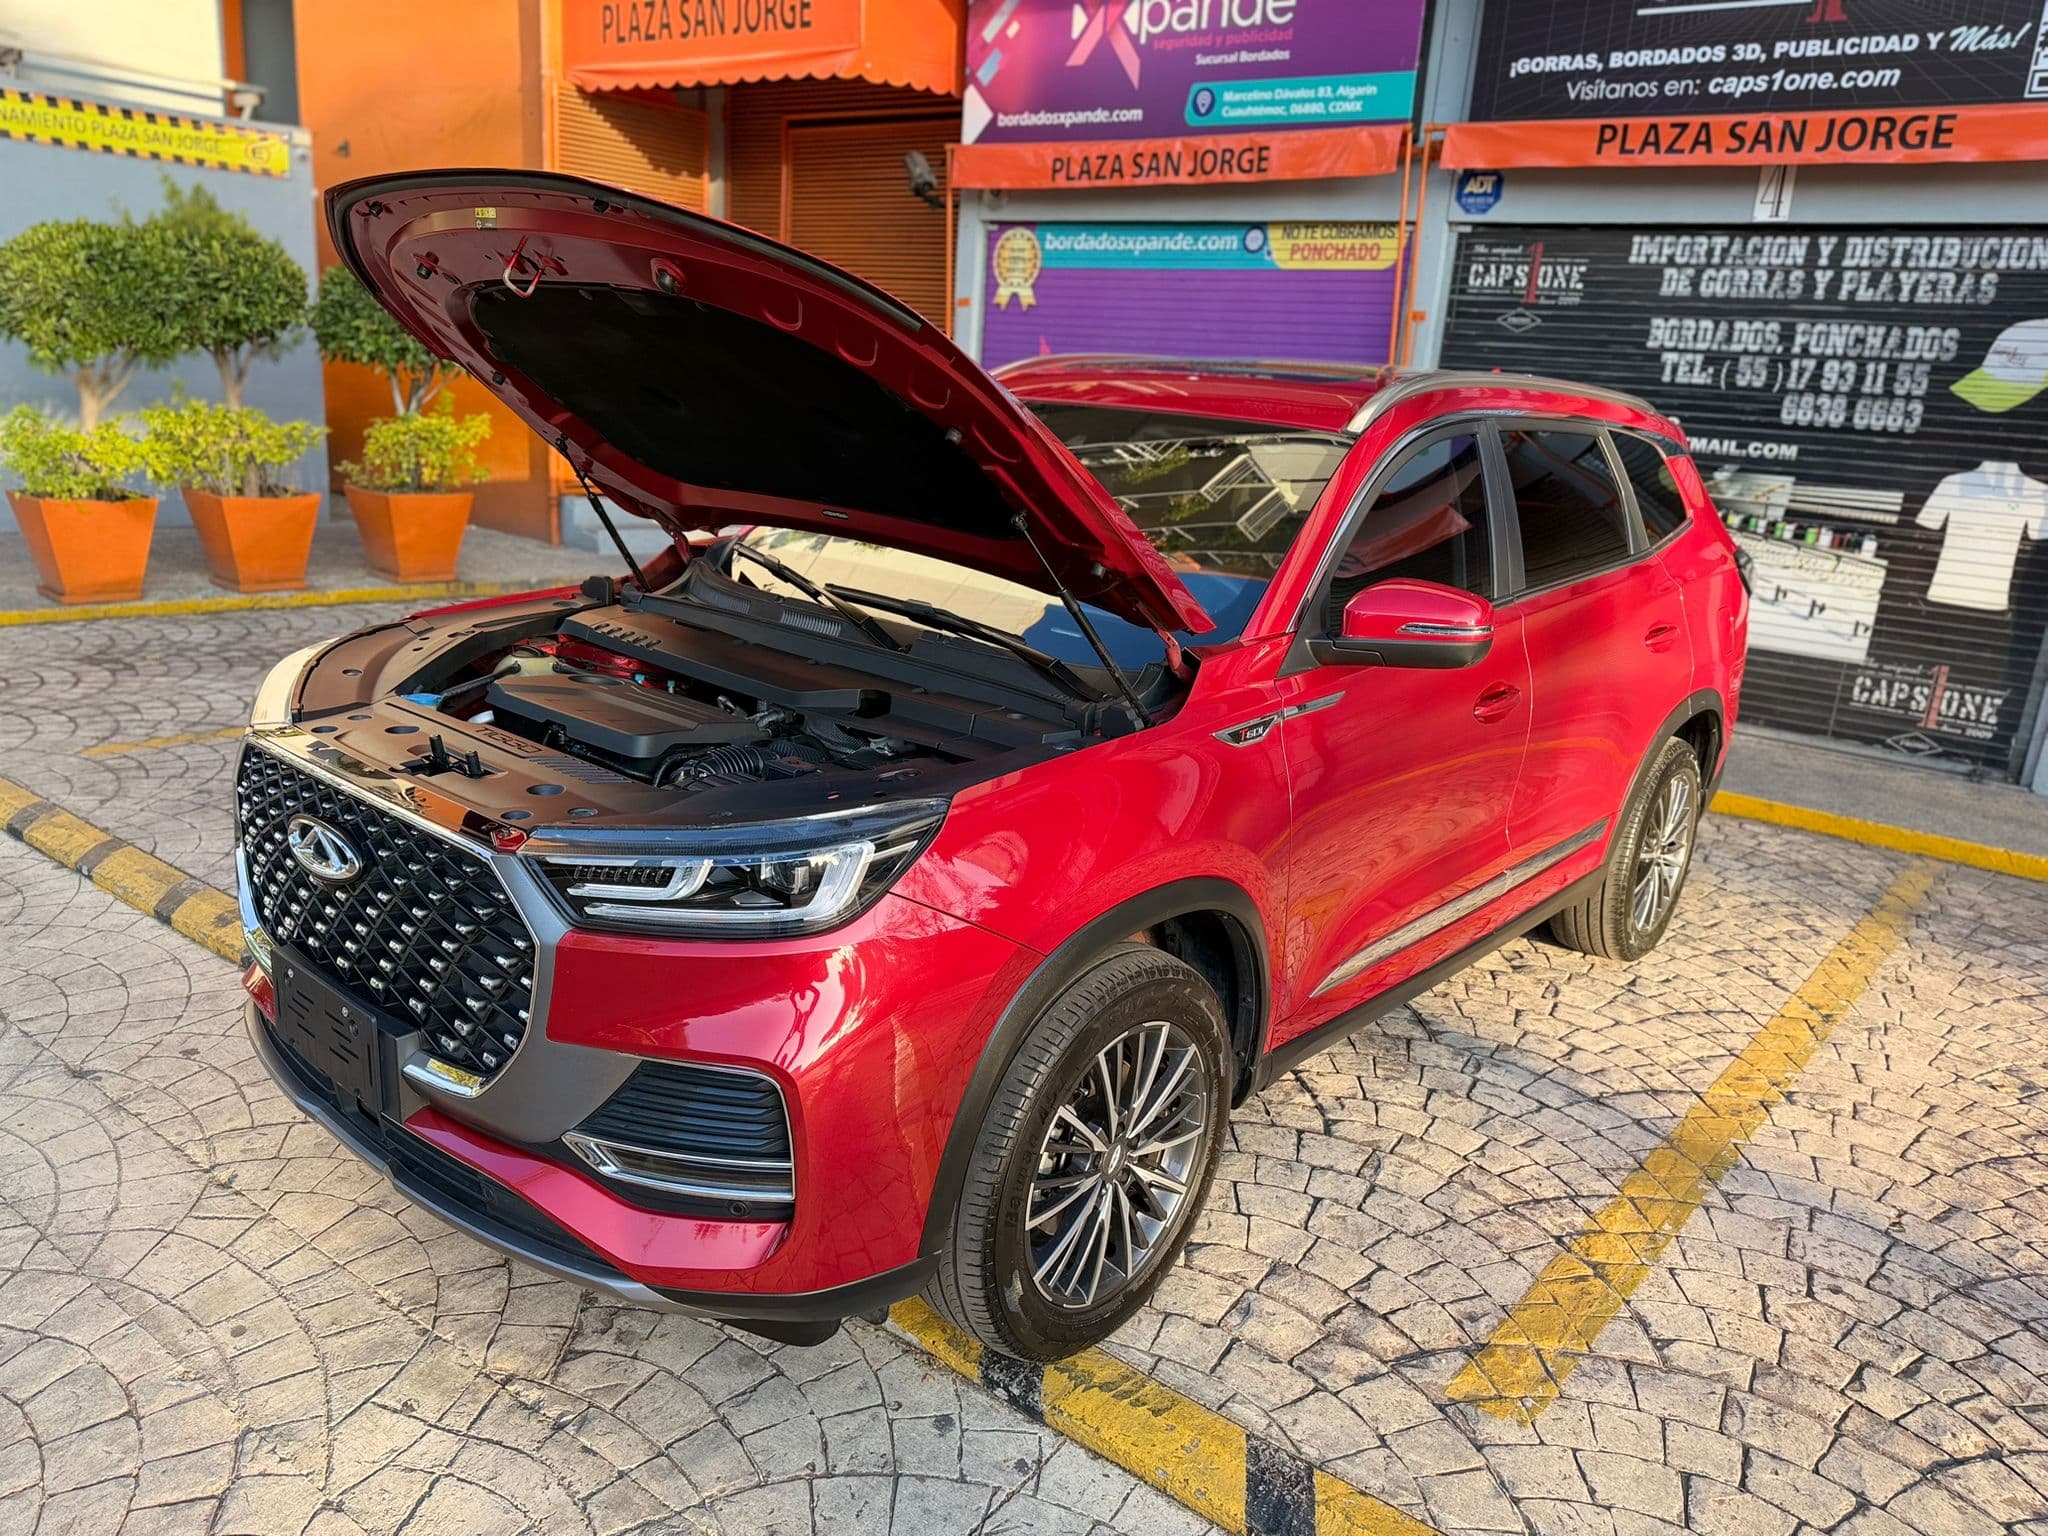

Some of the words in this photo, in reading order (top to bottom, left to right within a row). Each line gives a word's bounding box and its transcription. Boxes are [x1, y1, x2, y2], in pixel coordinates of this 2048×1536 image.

[602, 2, 673, 44] PLAZA
[680, 0, 725, 39] SAN
[732, 0, 812, 35] JORGE
[1153, 34, 1212, 50] seguridad
[1216, 35, 1222, 48] y
[1226, 29, 1293, 46] publicidad
[1509, 53, 1603, 79] ¡GORRAS,
[1609, 45, 1726, 68] BORDADOS
[1732, 43, 1767, 62] 3D,
[1774, 33, 1919, 59] PUBLICIDAD
[1926, 32, 1943, 50] Y
[1948, 22, 2032, 53] Más!
[1195, 51, 1238, 65] Sucursal
[1239, 49, 1290, 63] Bordados
[1223, 90, 1273, 102] Marcelino
[1275, 87, 1315, 100] Dávalos
[1567, 79, 1658, 100] Visítanos
[1664, 79, 1701, 97] en:
[1708, 68, 1901, 98] caps1one.com
[997, 108, 1143, 128] bordadosxpande.com
[1328, 101, 1363, 113] CDMX
[92, 122, 139, 141] PLAZA
[142, 129, 174, 148] SAN
[177, 135, 221, 154] JORGE
[1596, 122, 1713, 156] PLAZA
[1725, 119, 1807, 153] SAN
[1815, 114, 1958, 153] JORGE
[1052, 154, 1124, 182] PLAZA
[1132, 152, 1182, 178] SAN
[1188, 147, 1270, 177] JORGE
[1464, 175, 1498, 194] ADT
[1760, 165, 1786, 218] 4
[1045, 231, 1238, 255] bordadosxpande.com
[1282, 225, 1300, 240] NO
[1303, 225, 1319, 239] TE
[1320, 224, 1395, 239] COBRAMOS
[1289, 242, 1381, 261] PONCHADO
[1629, 236, 1810, 267] IMPORTACION
[1816, 236, 1838, 266] Y
[1659, 267, 1694, 297] DE
[1699, 268, 1805, 300] GORRAS
[1814, 270, 1834, 300] Y
[1838, 270, 1999, 304] PLAYERAS
[1791, 322, 1961, 361] PONCHADOS
[1660, 352, 1714, 385] TEL:
[1820, 360, 1857, 392] 93
[1860, 362, 1888, 394] 11
[1893, 363, 1931, 396] 55
[1780, 393, 1848, 427] 6838
[1687, 437, 1799, 461] MAIL.COM
